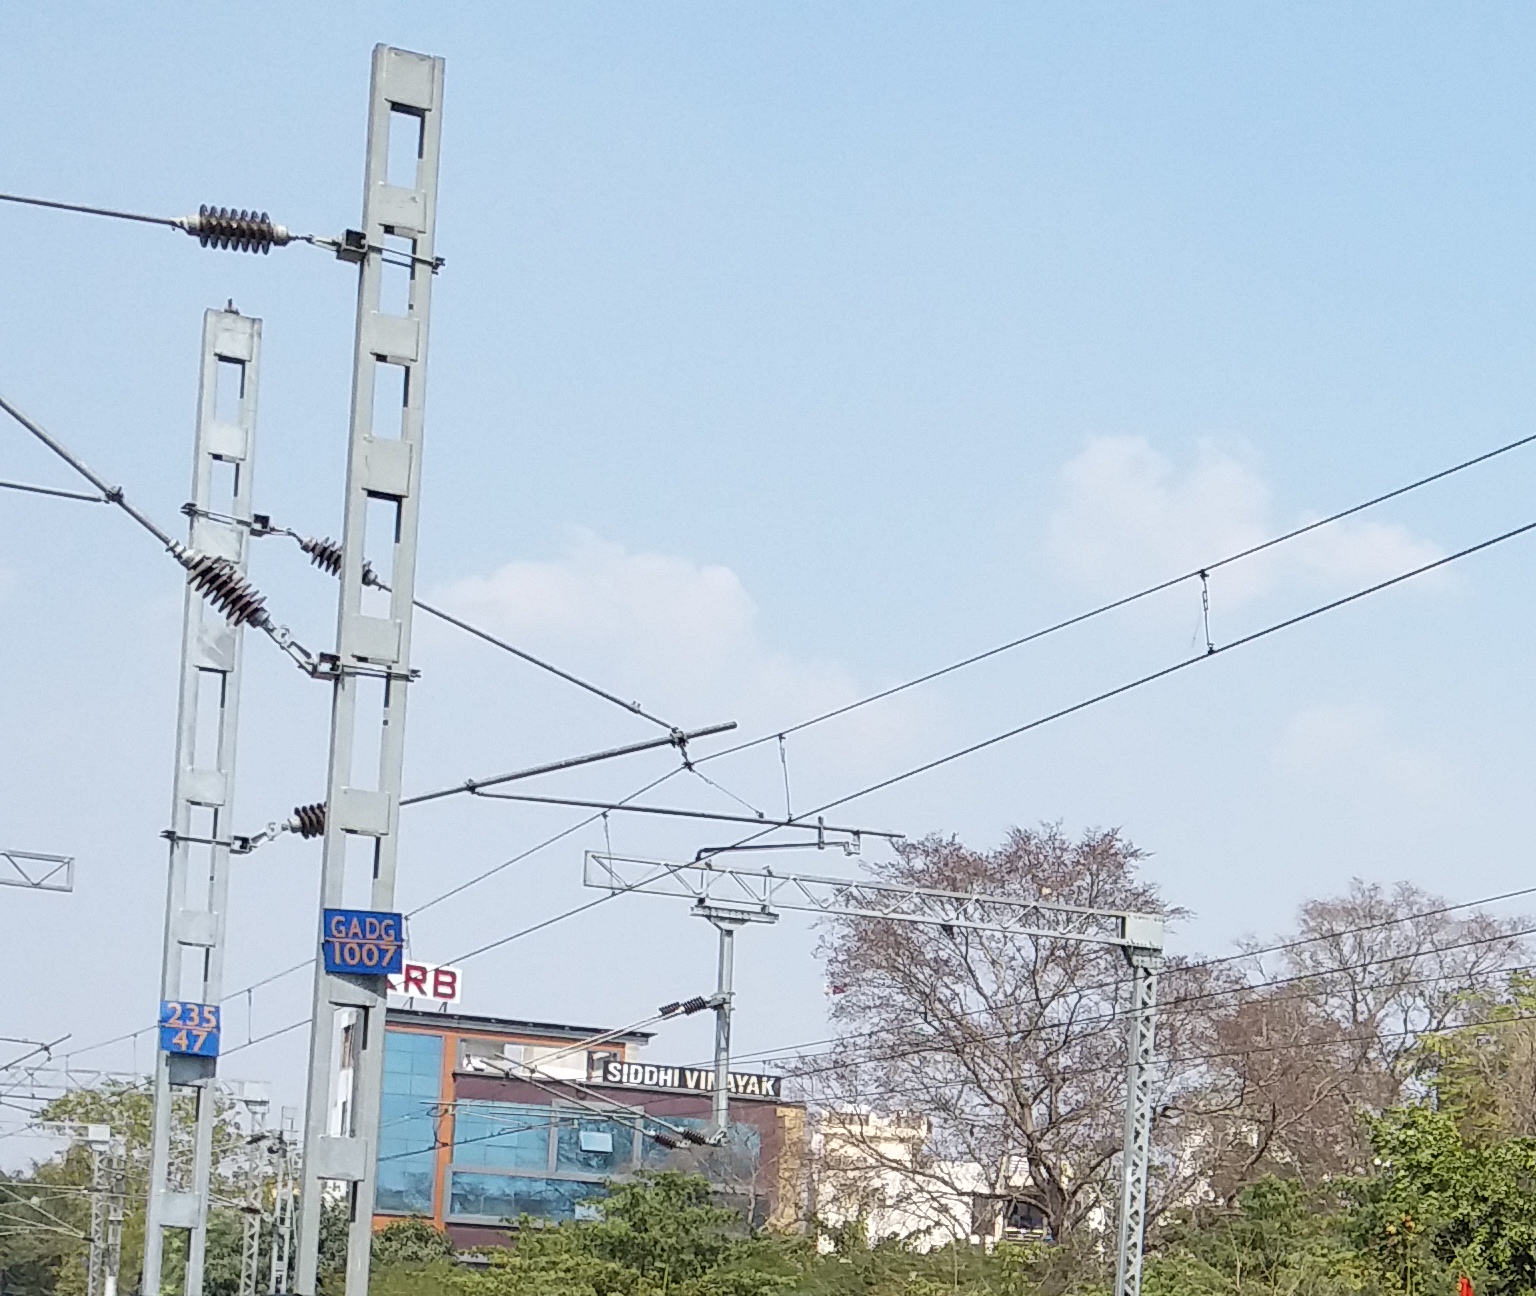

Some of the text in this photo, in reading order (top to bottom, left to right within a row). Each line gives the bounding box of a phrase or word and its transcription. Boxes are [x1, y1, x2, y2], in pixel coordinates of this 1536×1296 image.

[331, 916, 396, 942] GADG
[333, 943, 398, 967] 1007
[166, 1002, 217, 1028] 235
[171, 1031, 207, 1052] 47
[607, 1062, 680, 1087] SIDDHI
